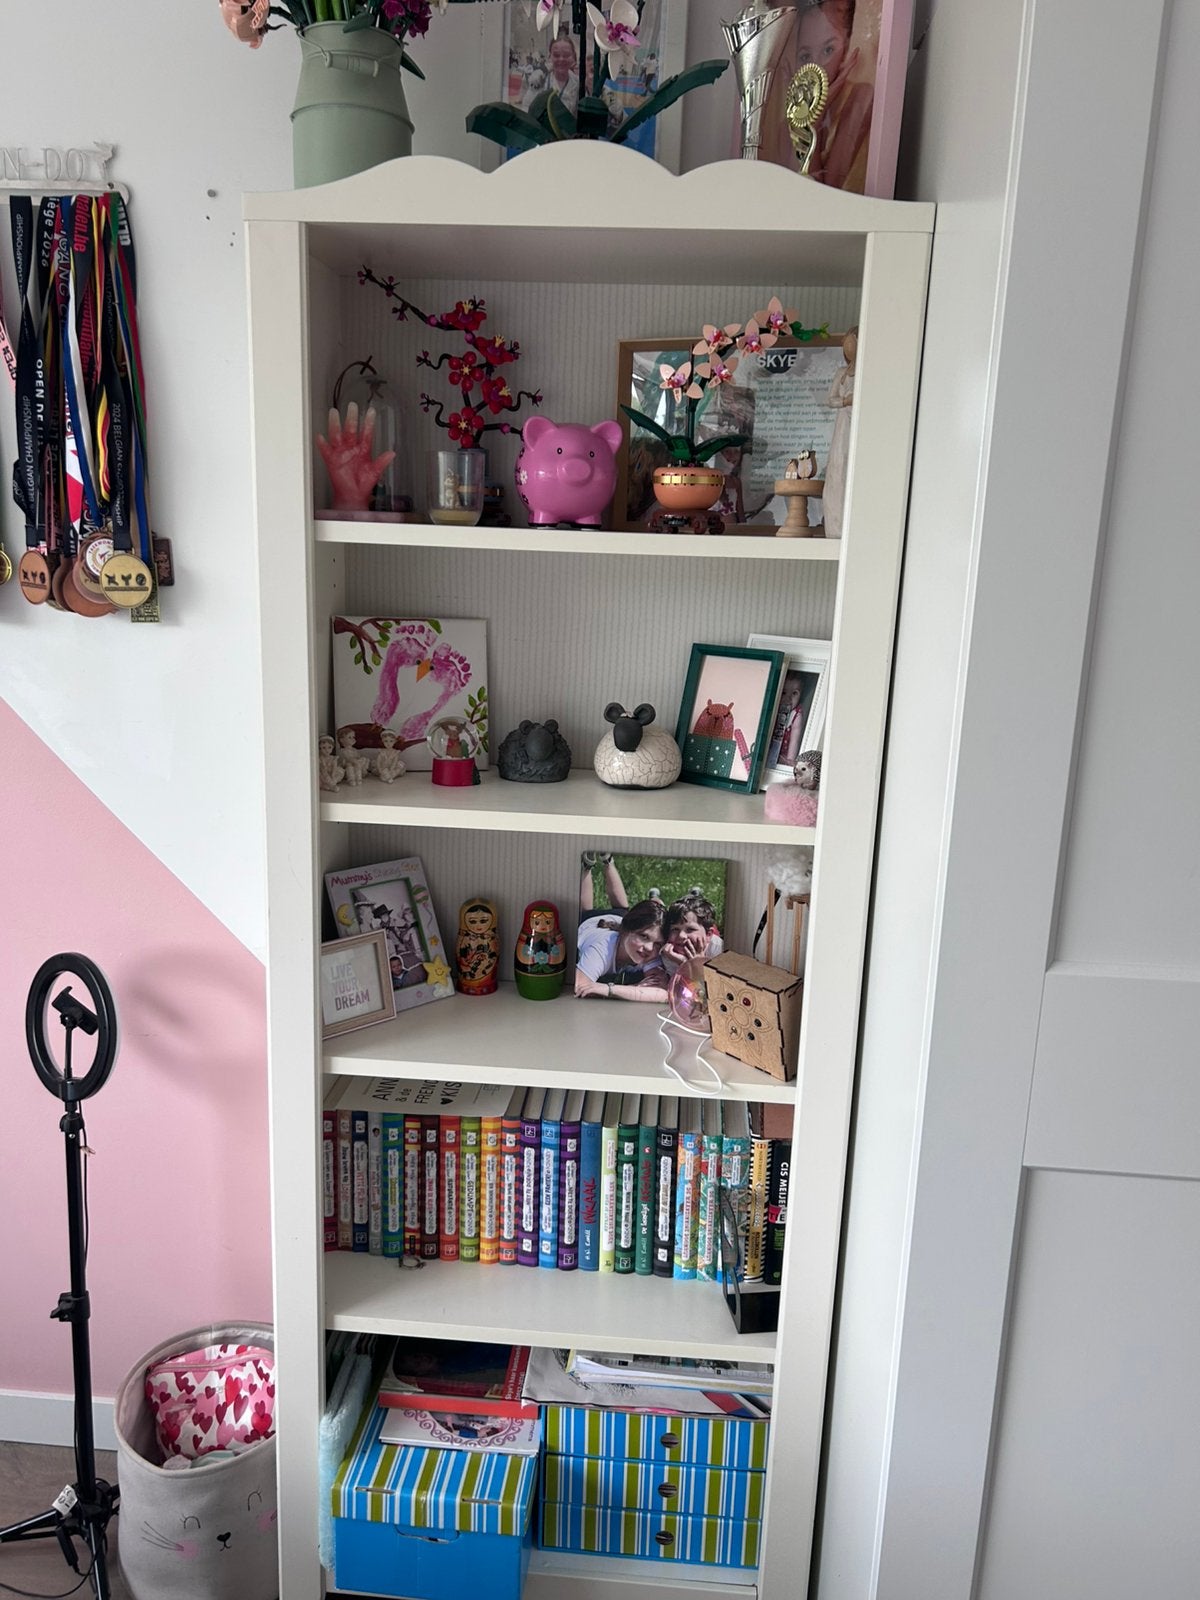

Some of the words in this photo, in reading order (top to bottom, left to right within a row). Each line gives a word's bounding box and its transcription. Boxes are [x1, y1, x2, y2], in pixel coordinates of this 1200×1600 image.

[756, 353, 798, 369] SKYE
[35, 358, 45, 400] OPEN
[112, 403, 121, 423] 2024
[22, 395, 35, 463] CHAMPIONSHIP
[113, 424, 123, 461] BELGIAN
[330, 962, 352, 980] LIVE
[332, 977, 359, 995] YOUR
[335, 989, 370, 1011] DREAM
[780, 1161, 789, 1176] CIS
